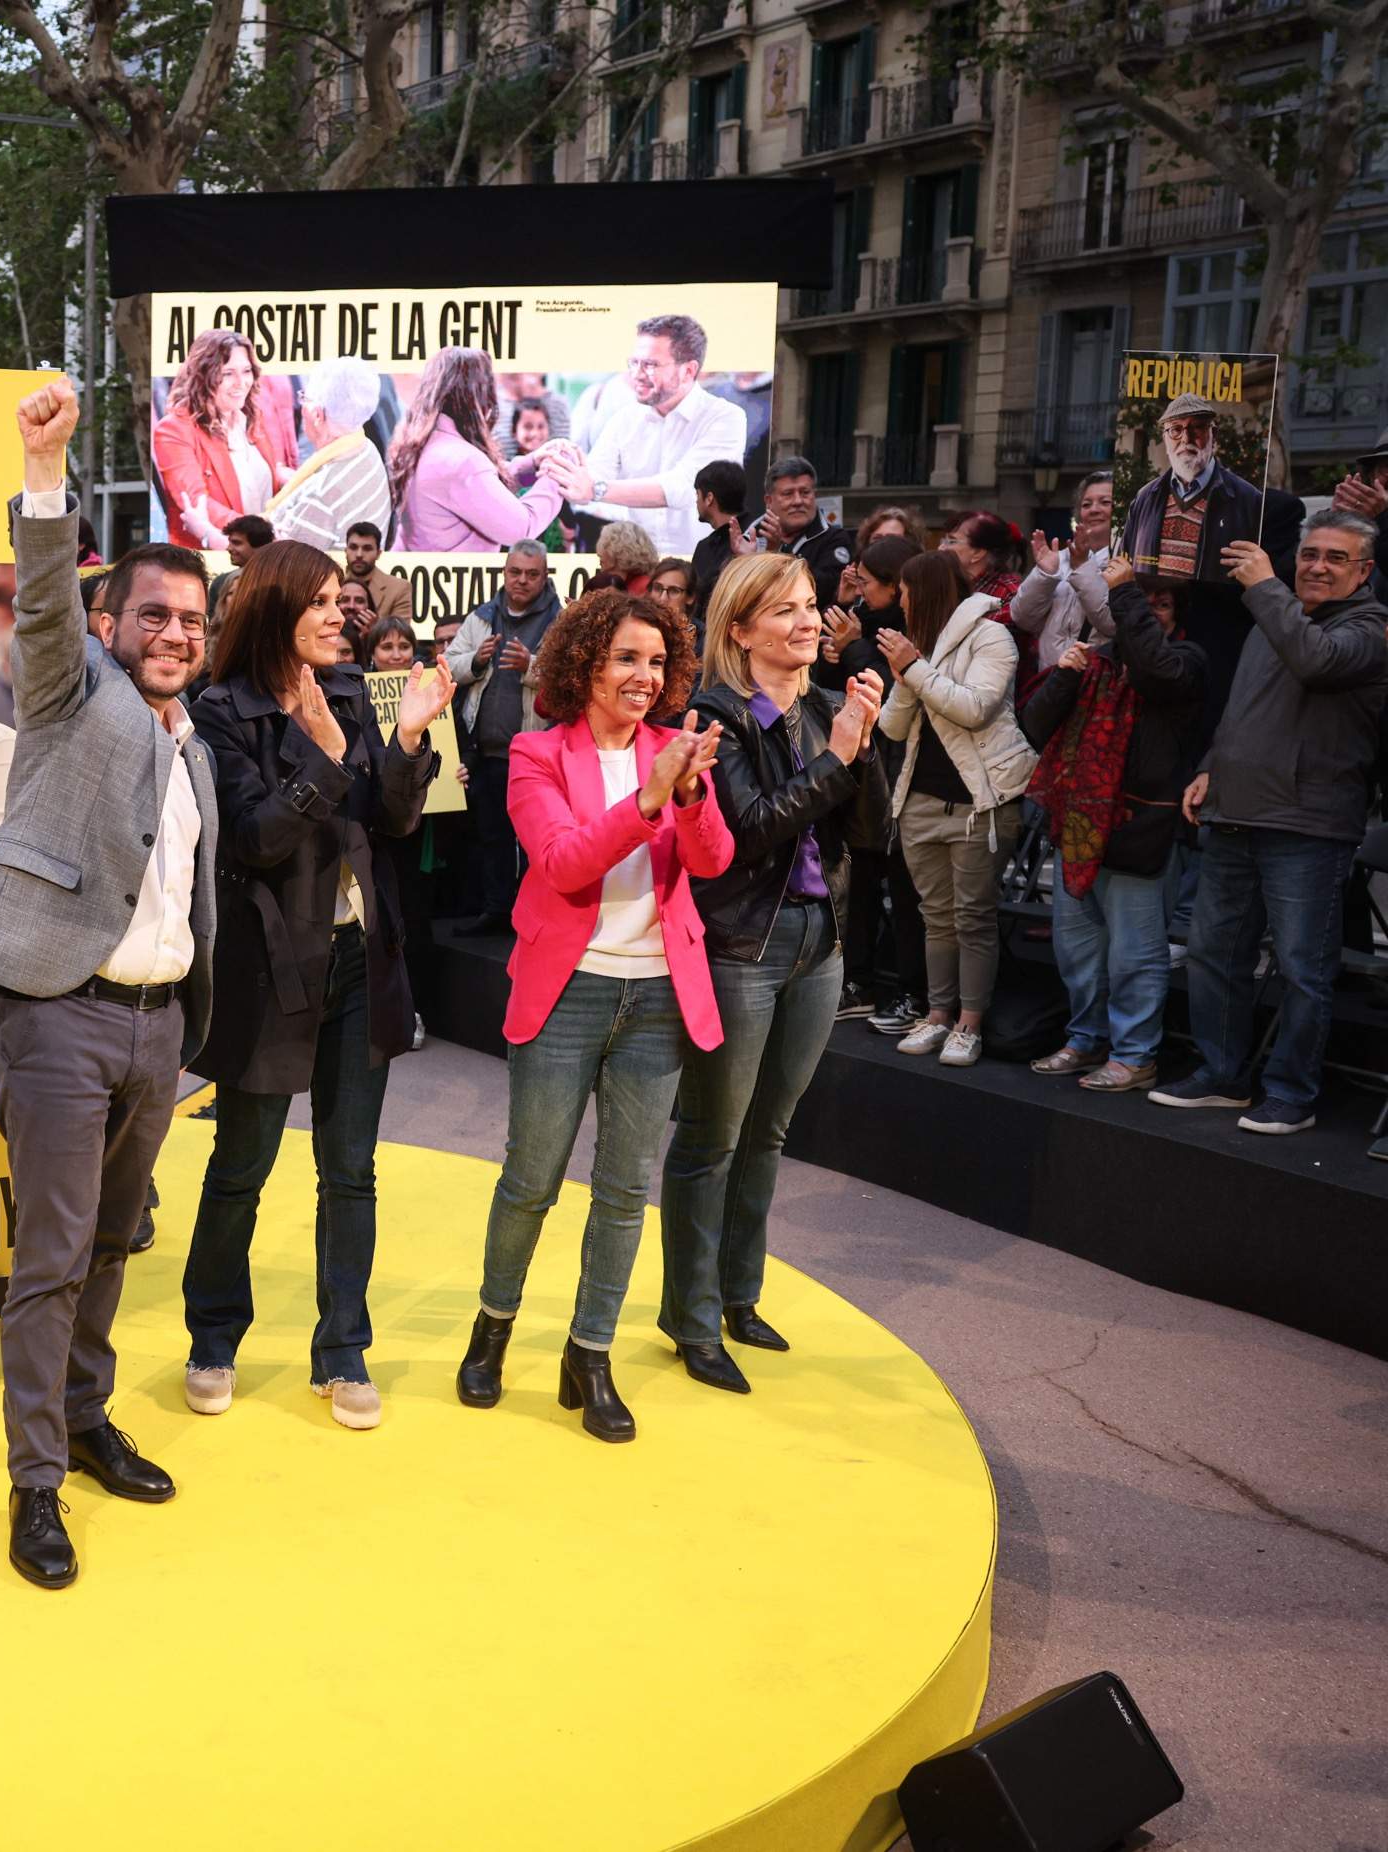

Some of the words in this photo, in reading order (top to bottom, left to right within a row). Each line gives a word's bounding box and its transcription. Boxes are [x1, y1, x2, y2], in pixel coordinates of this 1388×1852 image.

[338, 302, 379, 361] DE
[392, 302, 427, 361] LA
[440, 301, 522, 360] GENT
[1127, 354, 1242, 403] REPÚBLICA
